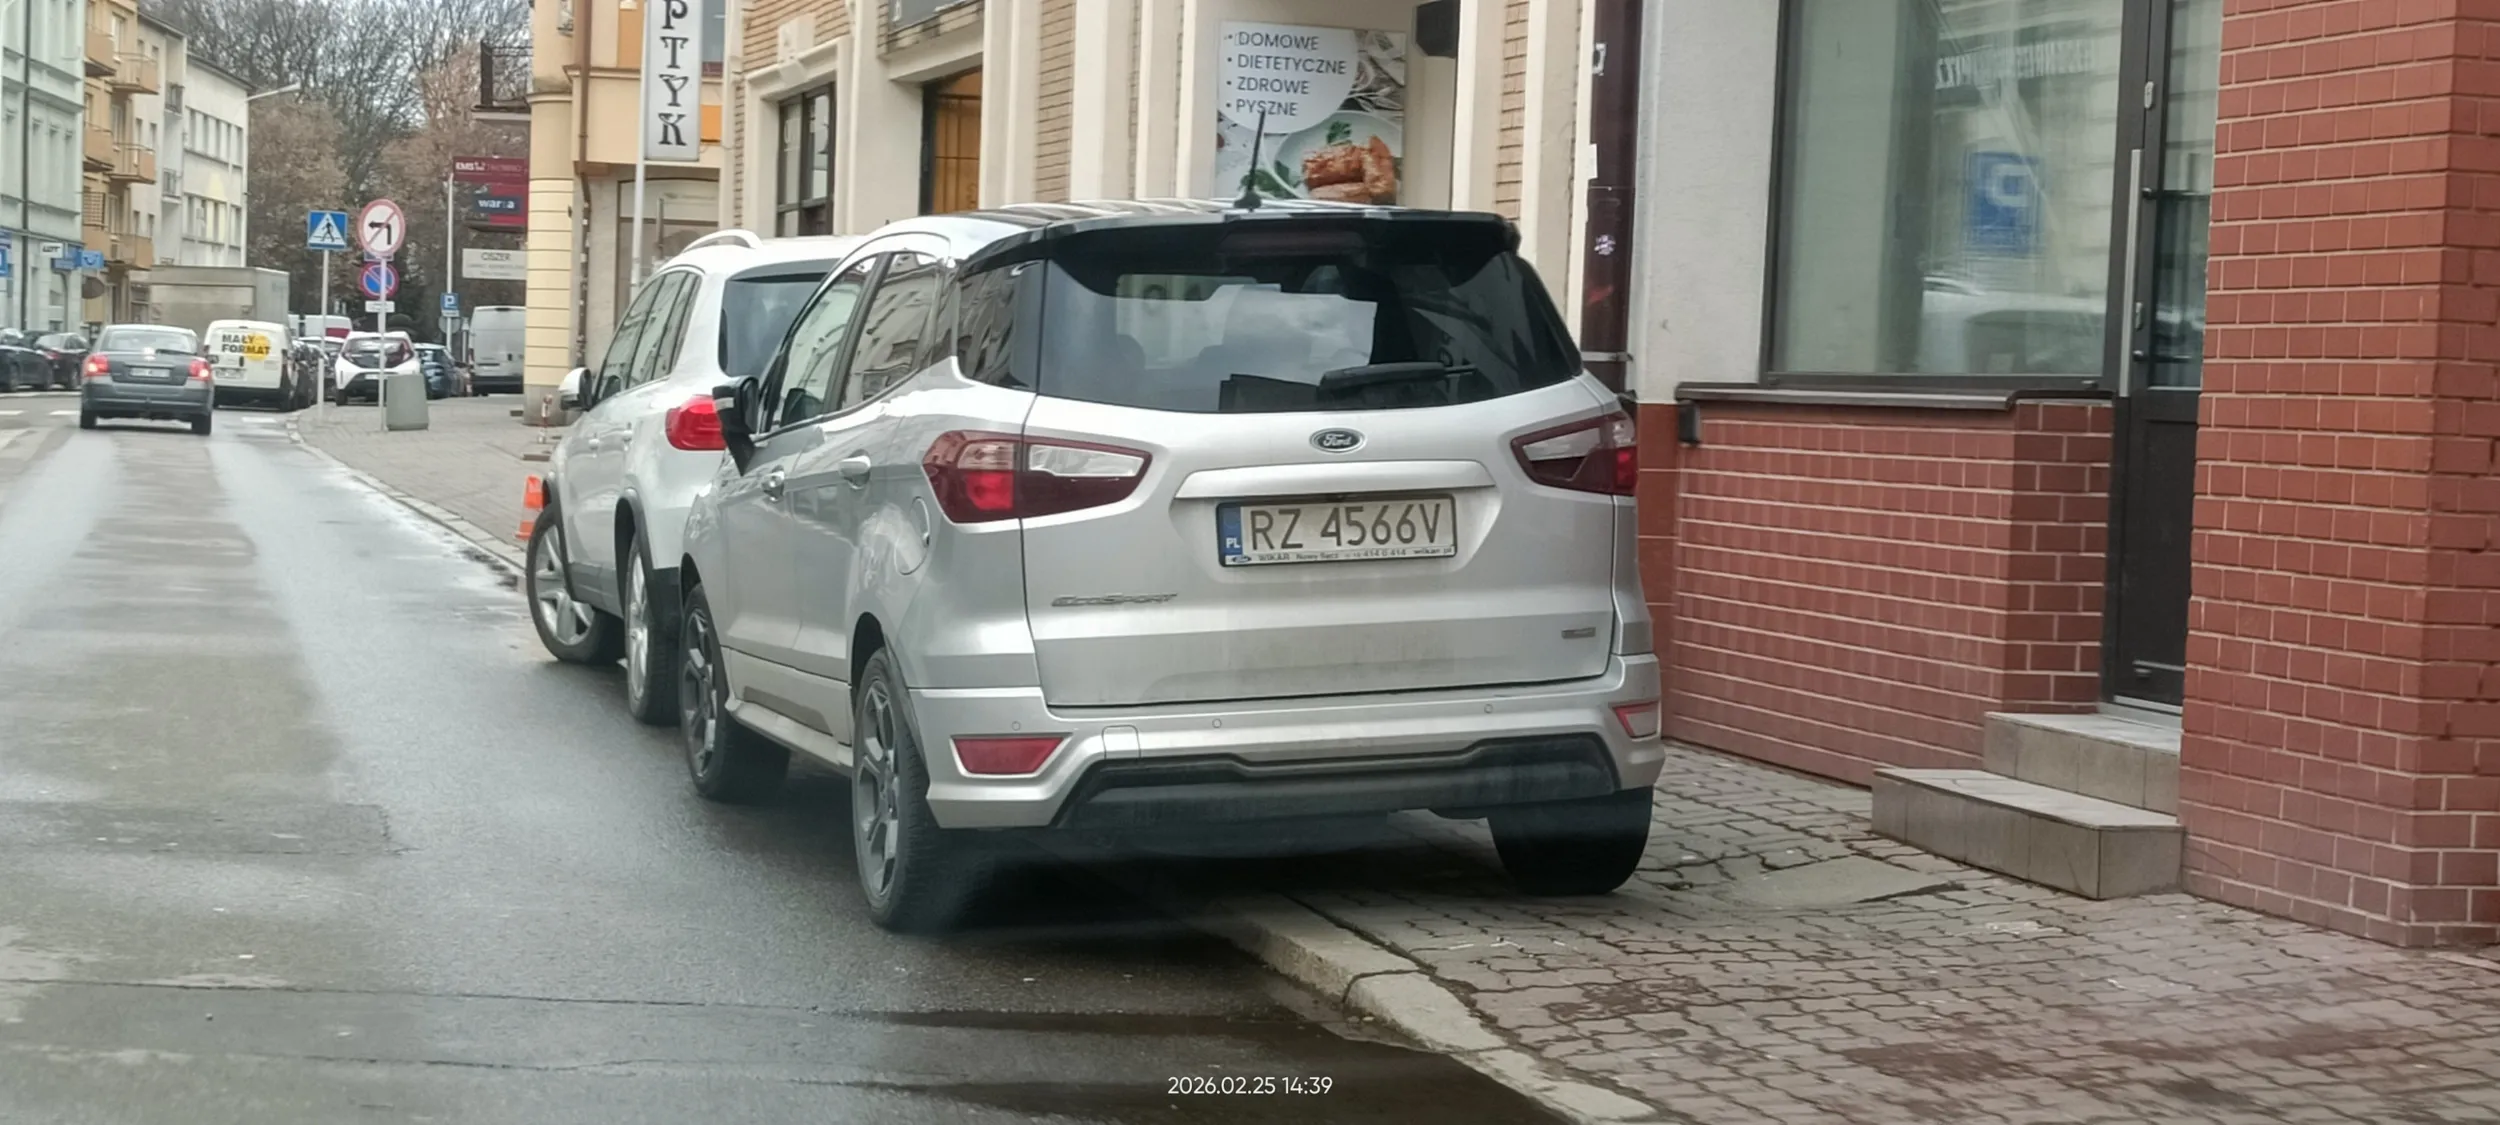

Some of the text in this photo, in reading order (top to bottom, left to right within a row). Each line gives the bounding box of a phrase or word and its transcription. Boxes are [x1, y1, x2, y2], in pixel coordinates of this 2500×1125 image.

[1237, 31, 1320, 51] DOMOWE
[1236, 53, 1348, 75] DIETETYCZNE
[1236, 76, 1311, 95] ZDROWE
[1235, 98, 1299, 117] PYSZNE
[221, 344, 271, 355] FORMAT
[1323, 433, 1352, 447] Ford
[1250, 502, 1441, 551] RZ 4566V
[1226, 537, 1241, 549] PL
